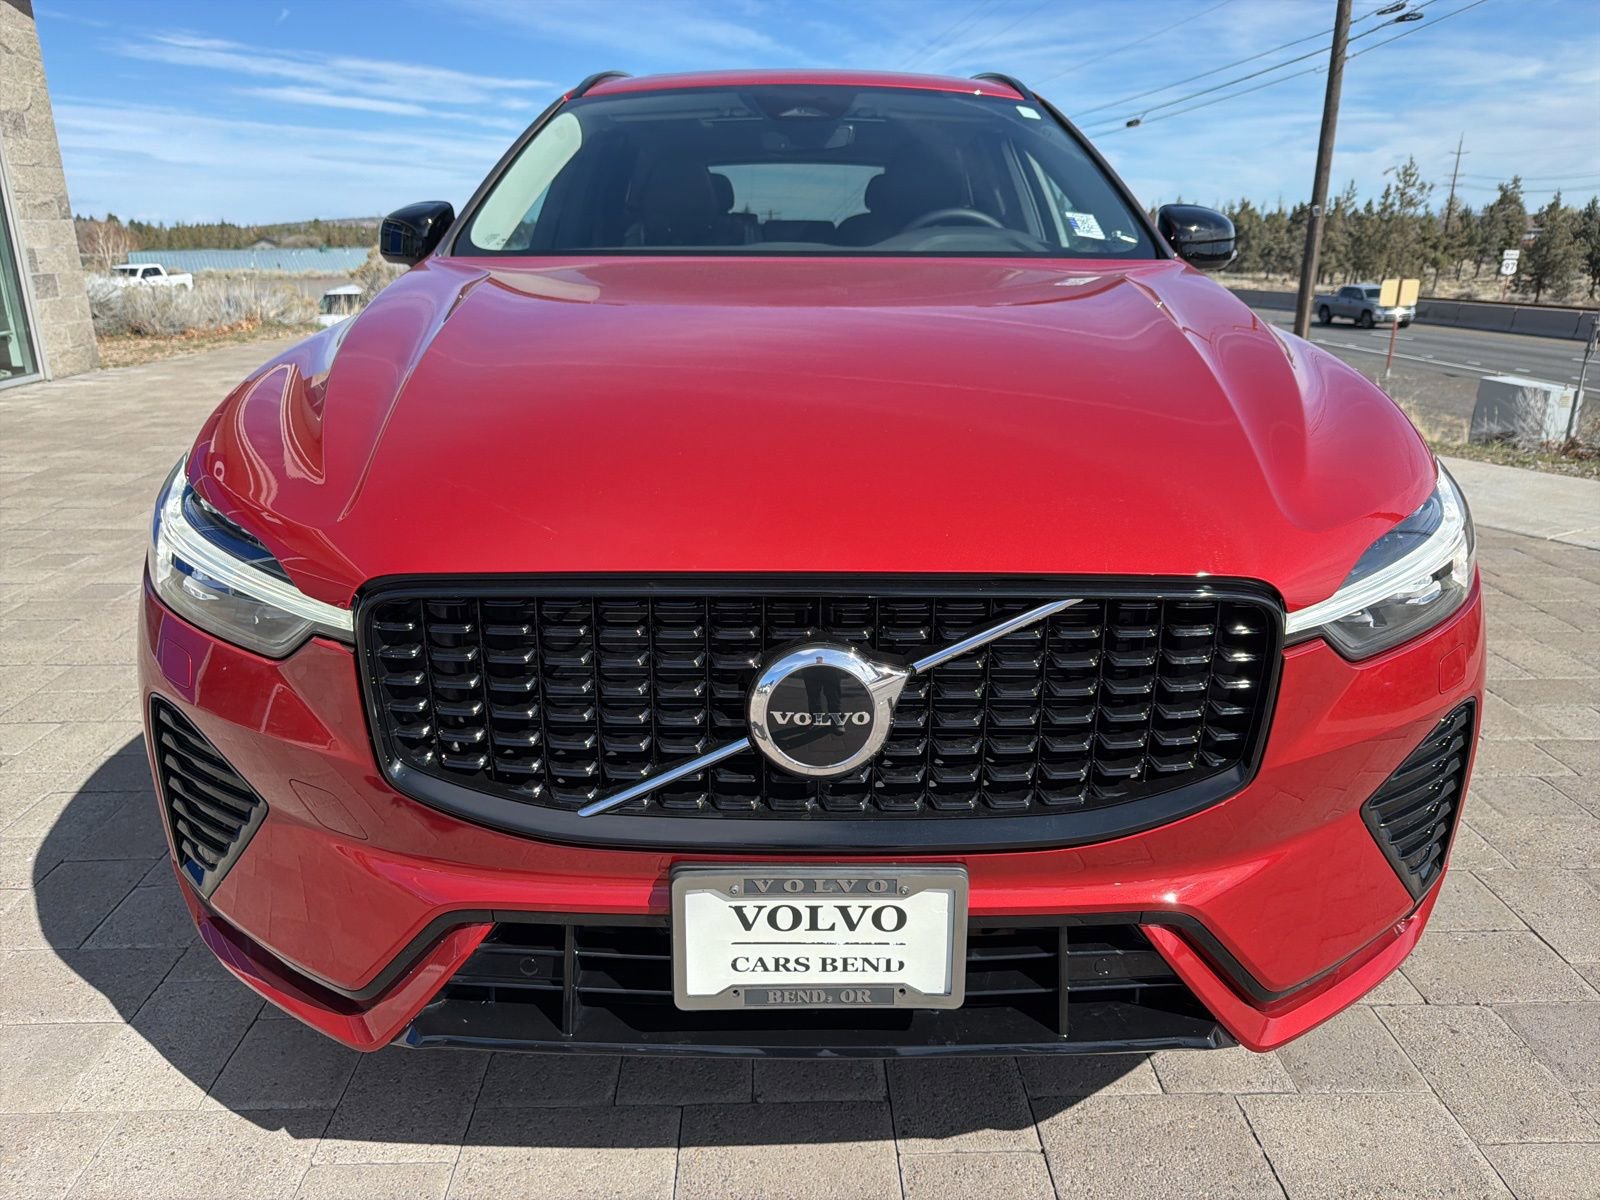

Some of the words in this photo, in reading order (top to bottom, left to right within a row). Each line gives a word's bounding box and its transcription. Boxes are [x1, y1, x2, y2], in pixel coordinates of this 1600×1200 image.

[1504, 262, 1516, 272] 97
[770, 711, 871, 726] VOLVO
[752, 879, 889, 894] VOLVO
[729, 904, 907, 932] VOLVO
[731, 956, 811, 973] CARS
[819, 956, 905, 973] BEND
[839, 988, 873, 1003] OR
